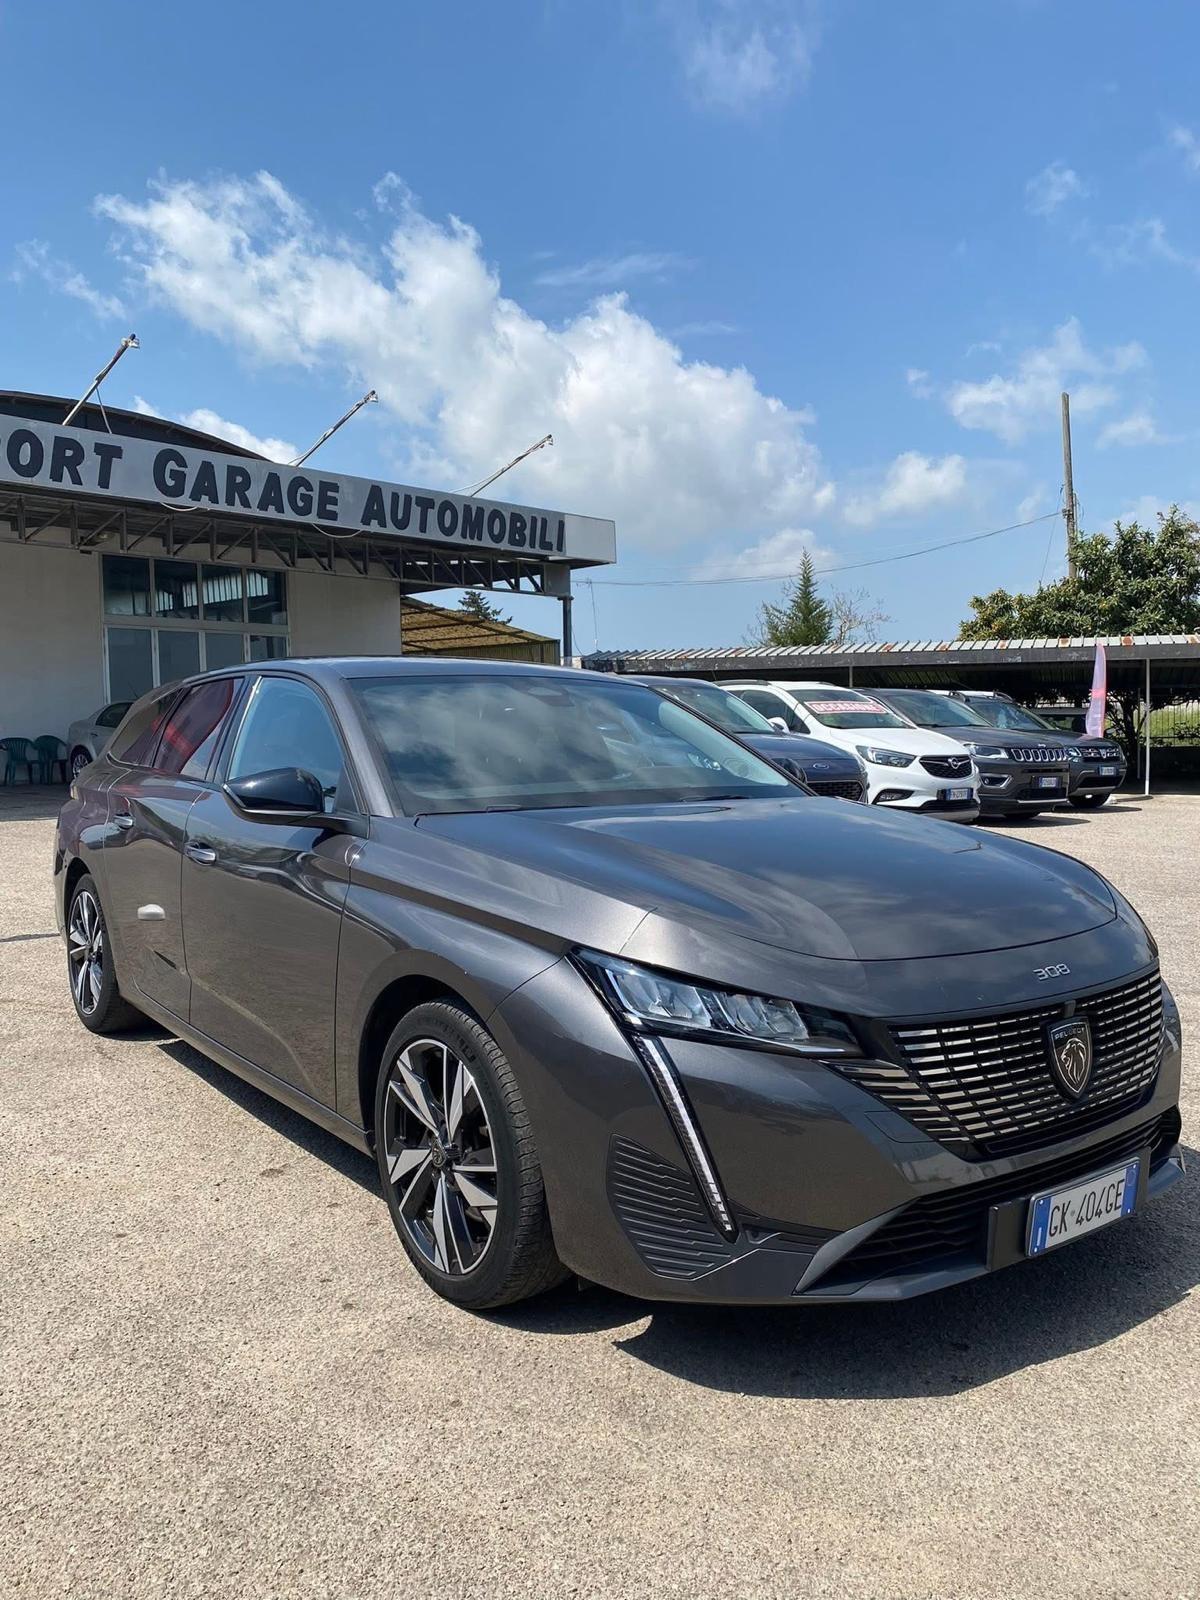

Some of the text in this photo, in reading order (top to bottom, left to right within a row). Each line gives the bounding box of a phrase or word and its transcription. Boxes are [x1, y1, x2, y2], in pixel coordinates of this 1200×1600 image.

[0, 429, 564, 552] ORT GARAGE AUTOMOBILI
[1032, 963, 1070, 980] 308
[1049, 1179, 1125, 1237] GK 404GE
